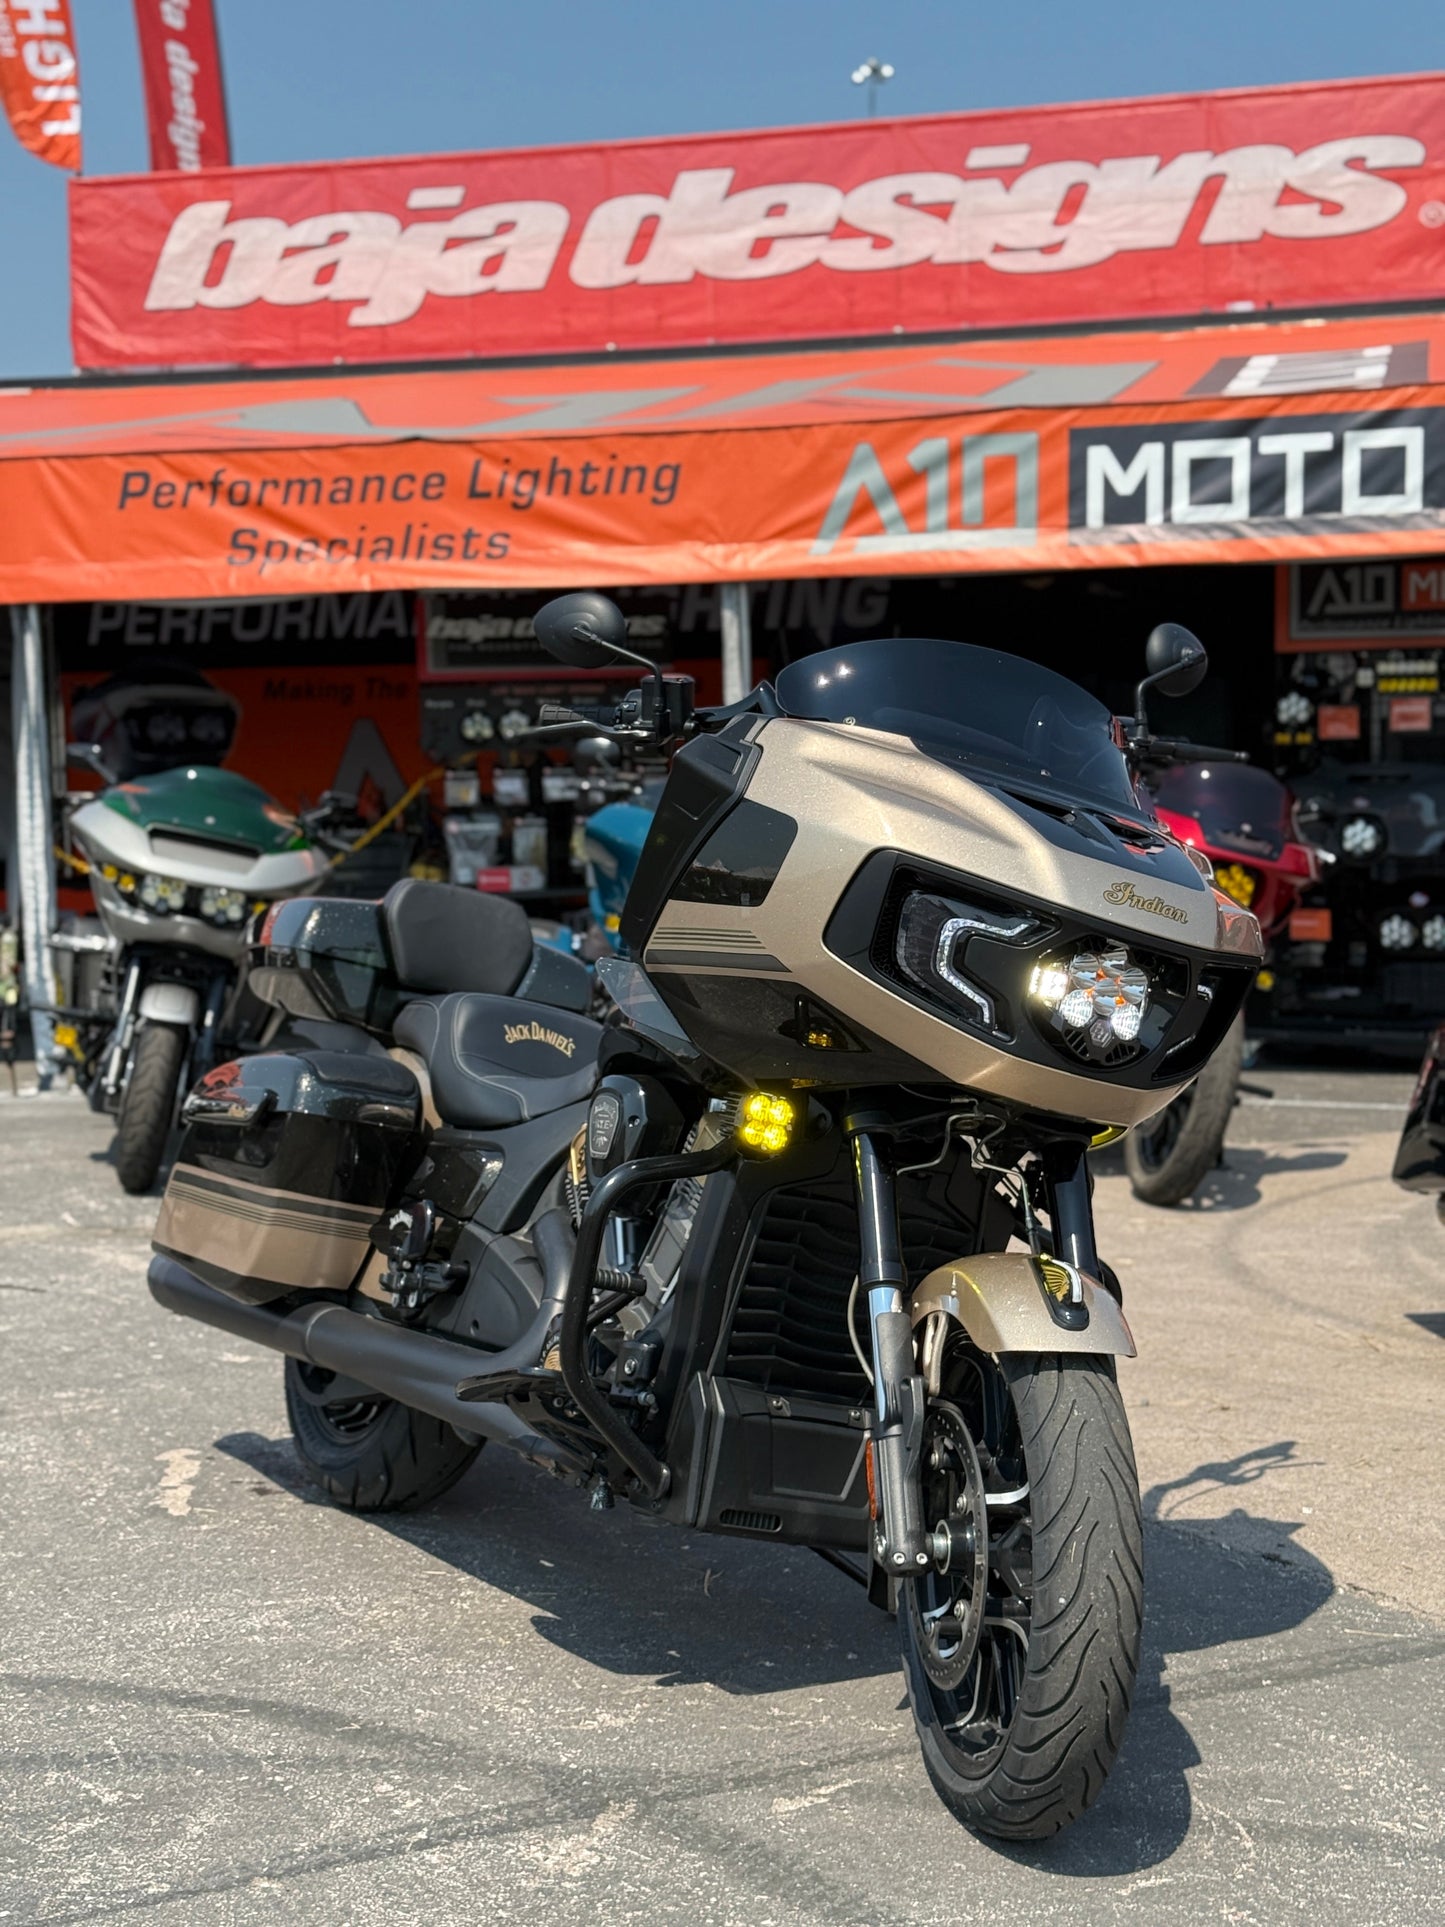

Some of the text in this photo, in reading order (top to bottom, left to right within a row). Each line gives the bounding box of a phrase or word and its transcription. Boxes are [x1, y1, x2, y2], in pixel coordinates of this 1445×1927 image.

[144, 134, 1426, 327] baja designs
[117, 452, 683, 514] Performance Lighting
[809, 426, 1424, 556] A10 MOTO
[226, 524, 512, 576] Specialists
[1306, 565, 1396, 617] A10
[86, 591, 413, 648] PERFORMA
[1103, 881, 1189, 925] Indian
[503, 1020, 576, 1059] JACK DANIEL'S
